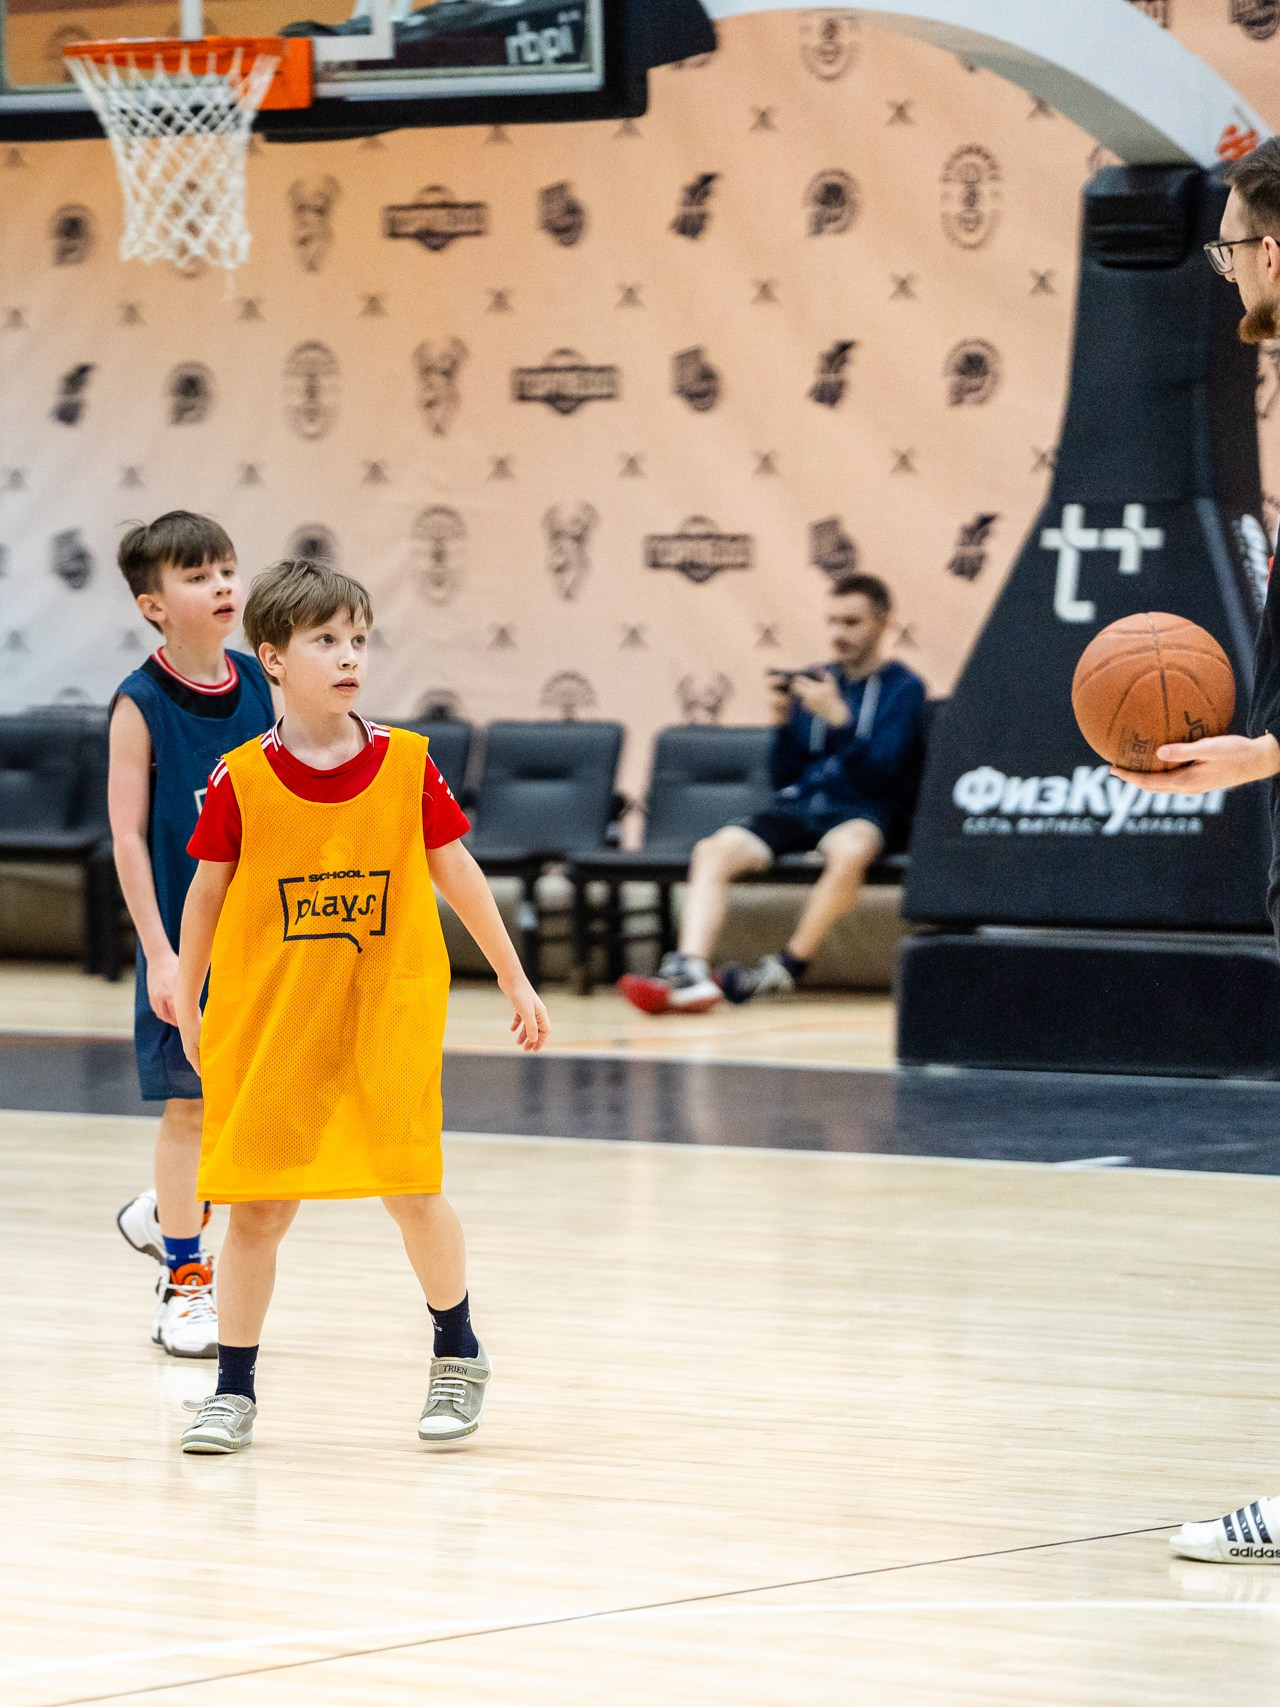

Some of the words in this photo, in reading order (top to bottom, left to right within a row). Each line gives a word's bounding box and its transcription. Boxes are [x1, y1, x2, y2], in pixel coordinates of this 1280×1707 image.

[308, 870, 366, 882] SCHOOL
[294, 890, 377, 926] plays
[1229, 1546, 1280, 1558] adidas
